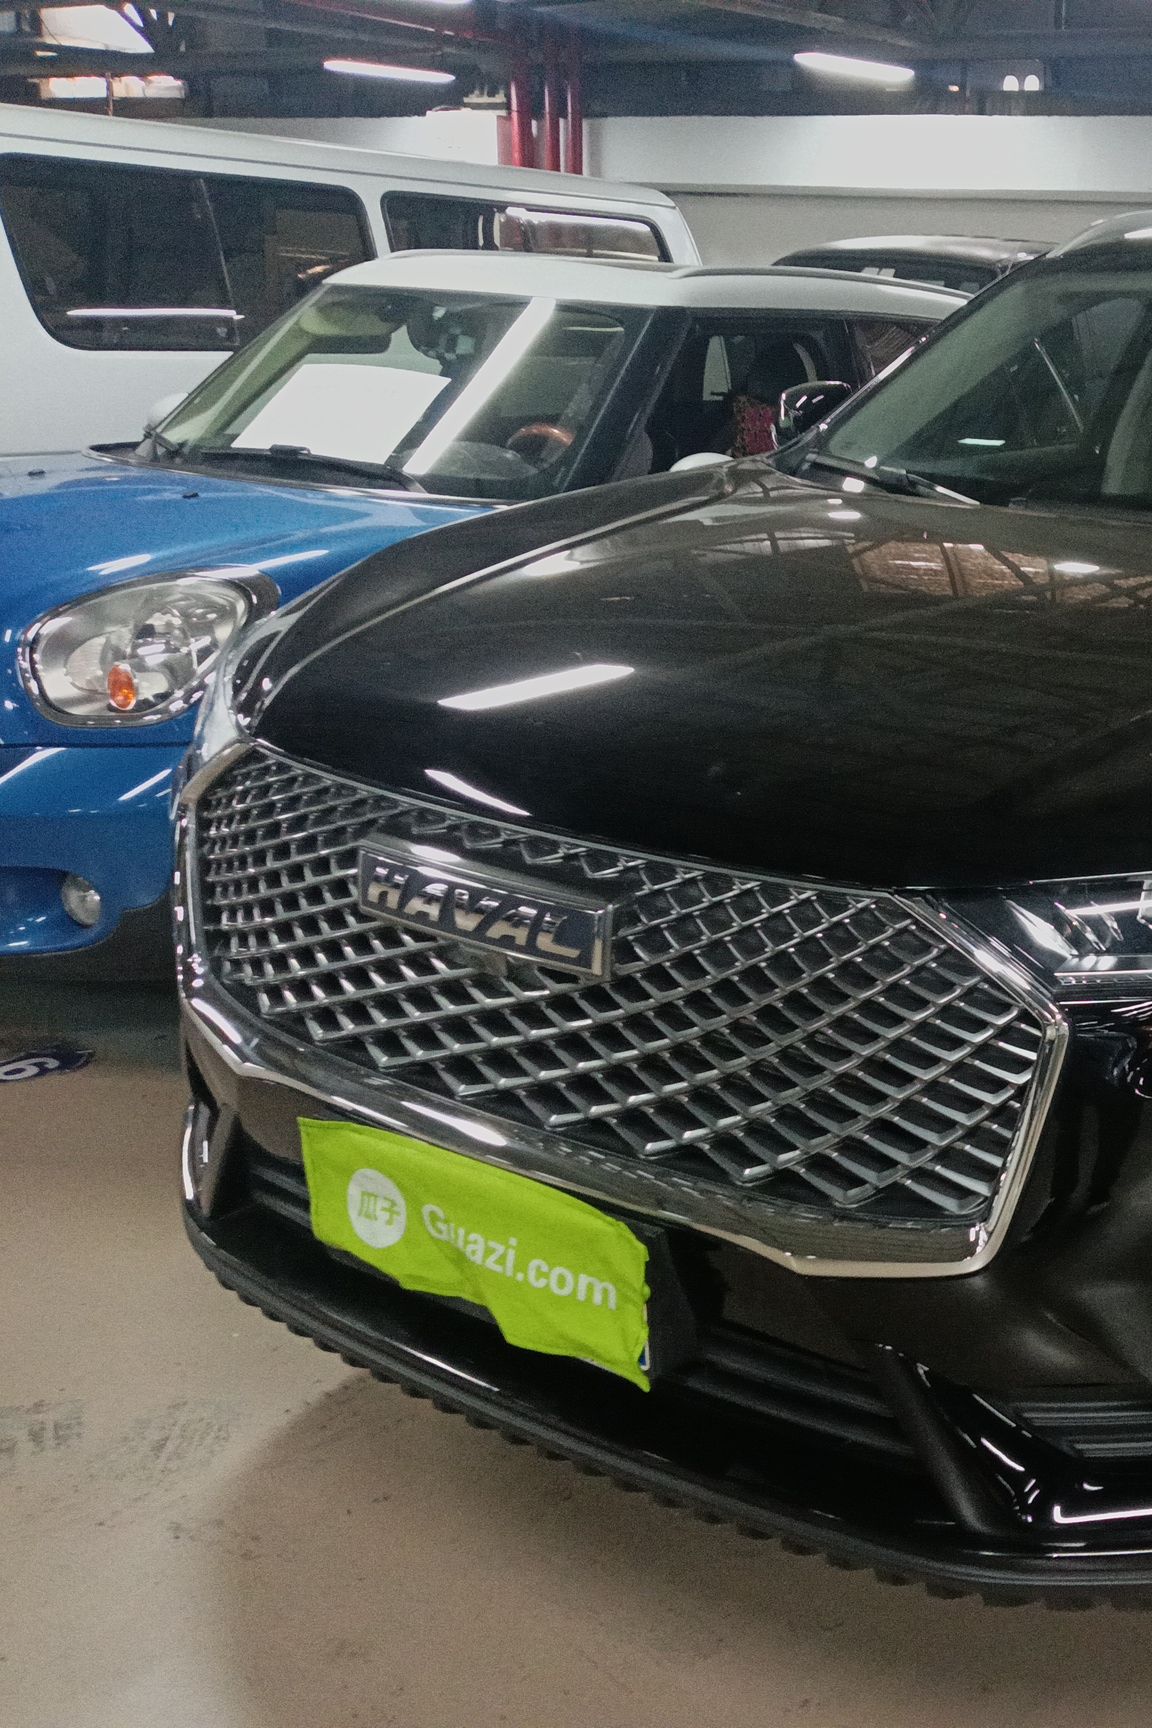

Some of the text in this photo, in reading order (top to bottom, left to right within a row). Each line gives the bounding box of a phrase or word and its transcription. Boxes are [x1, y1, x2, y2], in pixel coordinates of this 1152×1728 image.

[367, 866, 582, 958] HAVAL
[358, 1190, 401, 1226] 瓜子
[421, 1203, 618, 1311] Guazi.com
